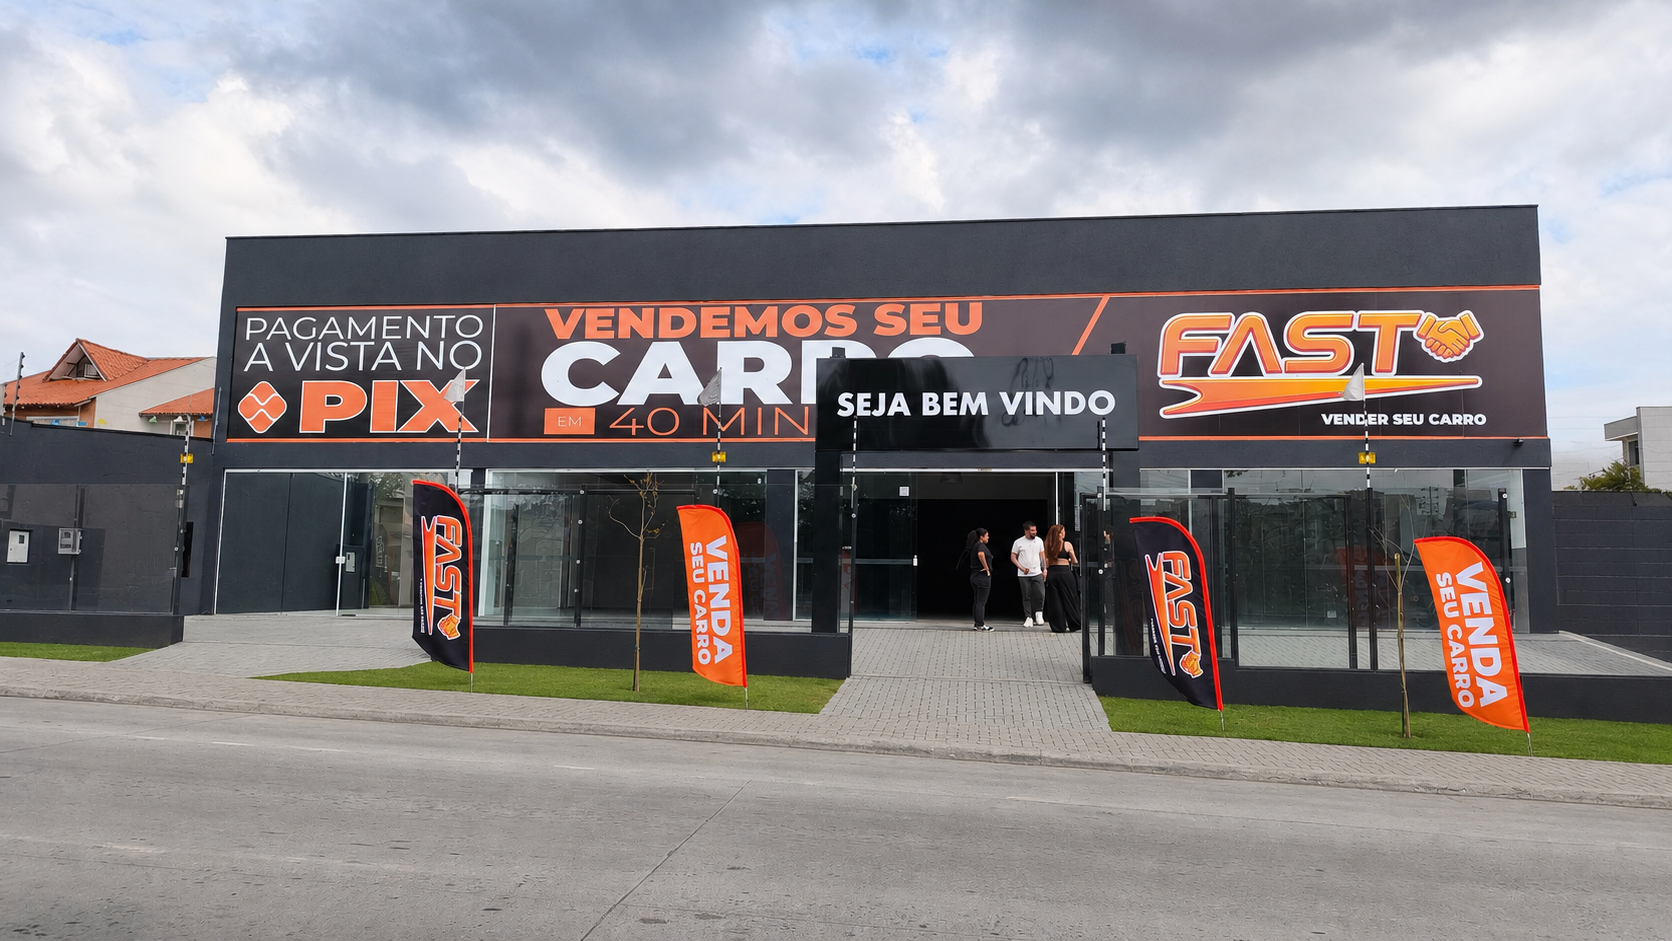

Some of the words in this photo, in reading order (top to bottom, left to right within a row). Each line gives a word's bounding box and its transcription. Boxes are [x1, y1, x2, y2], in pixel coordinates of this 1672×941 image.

[245, 314, 484, 341] PAGAMENTO
[544, 303, 858, 340] VENDEMOS
[873, 301, 983, 336] SEU
[1157, 310, 1426, 378] FAST
[243, 342, 274, 372] A
[284, 341, 402, 372] VISTA
[416, 340, 482, 371] NO
[540, 337, 975, 407] CAR
[298, 379, 480, 433] PIX
[557, 415, 582, 427] EM
[608, 407, 680, 436] 40
[836, 391, 911, 417] SEJA
[922, 391, 989, 416] BEM
[999, 389, 1116, 416] VINDO
[1321, 413, 1389, 426] VENDER
[1392, 413, 1424, 426] SEU
[1428, 413, 1487, 426] CARRO
[434, 515, 463, 620] FAST
[690, 541, 705, 583] SEU
[705, 535, 733, 665] VENDA
[1161, 550, 1201, 656] FAST
[1435, 572, 1459, 618] SEU
[693, 589, 711, 665] CARRO
[1455, 561, 1508, 708] VENDA
[1446, 624, 1475, 708] CARRO
